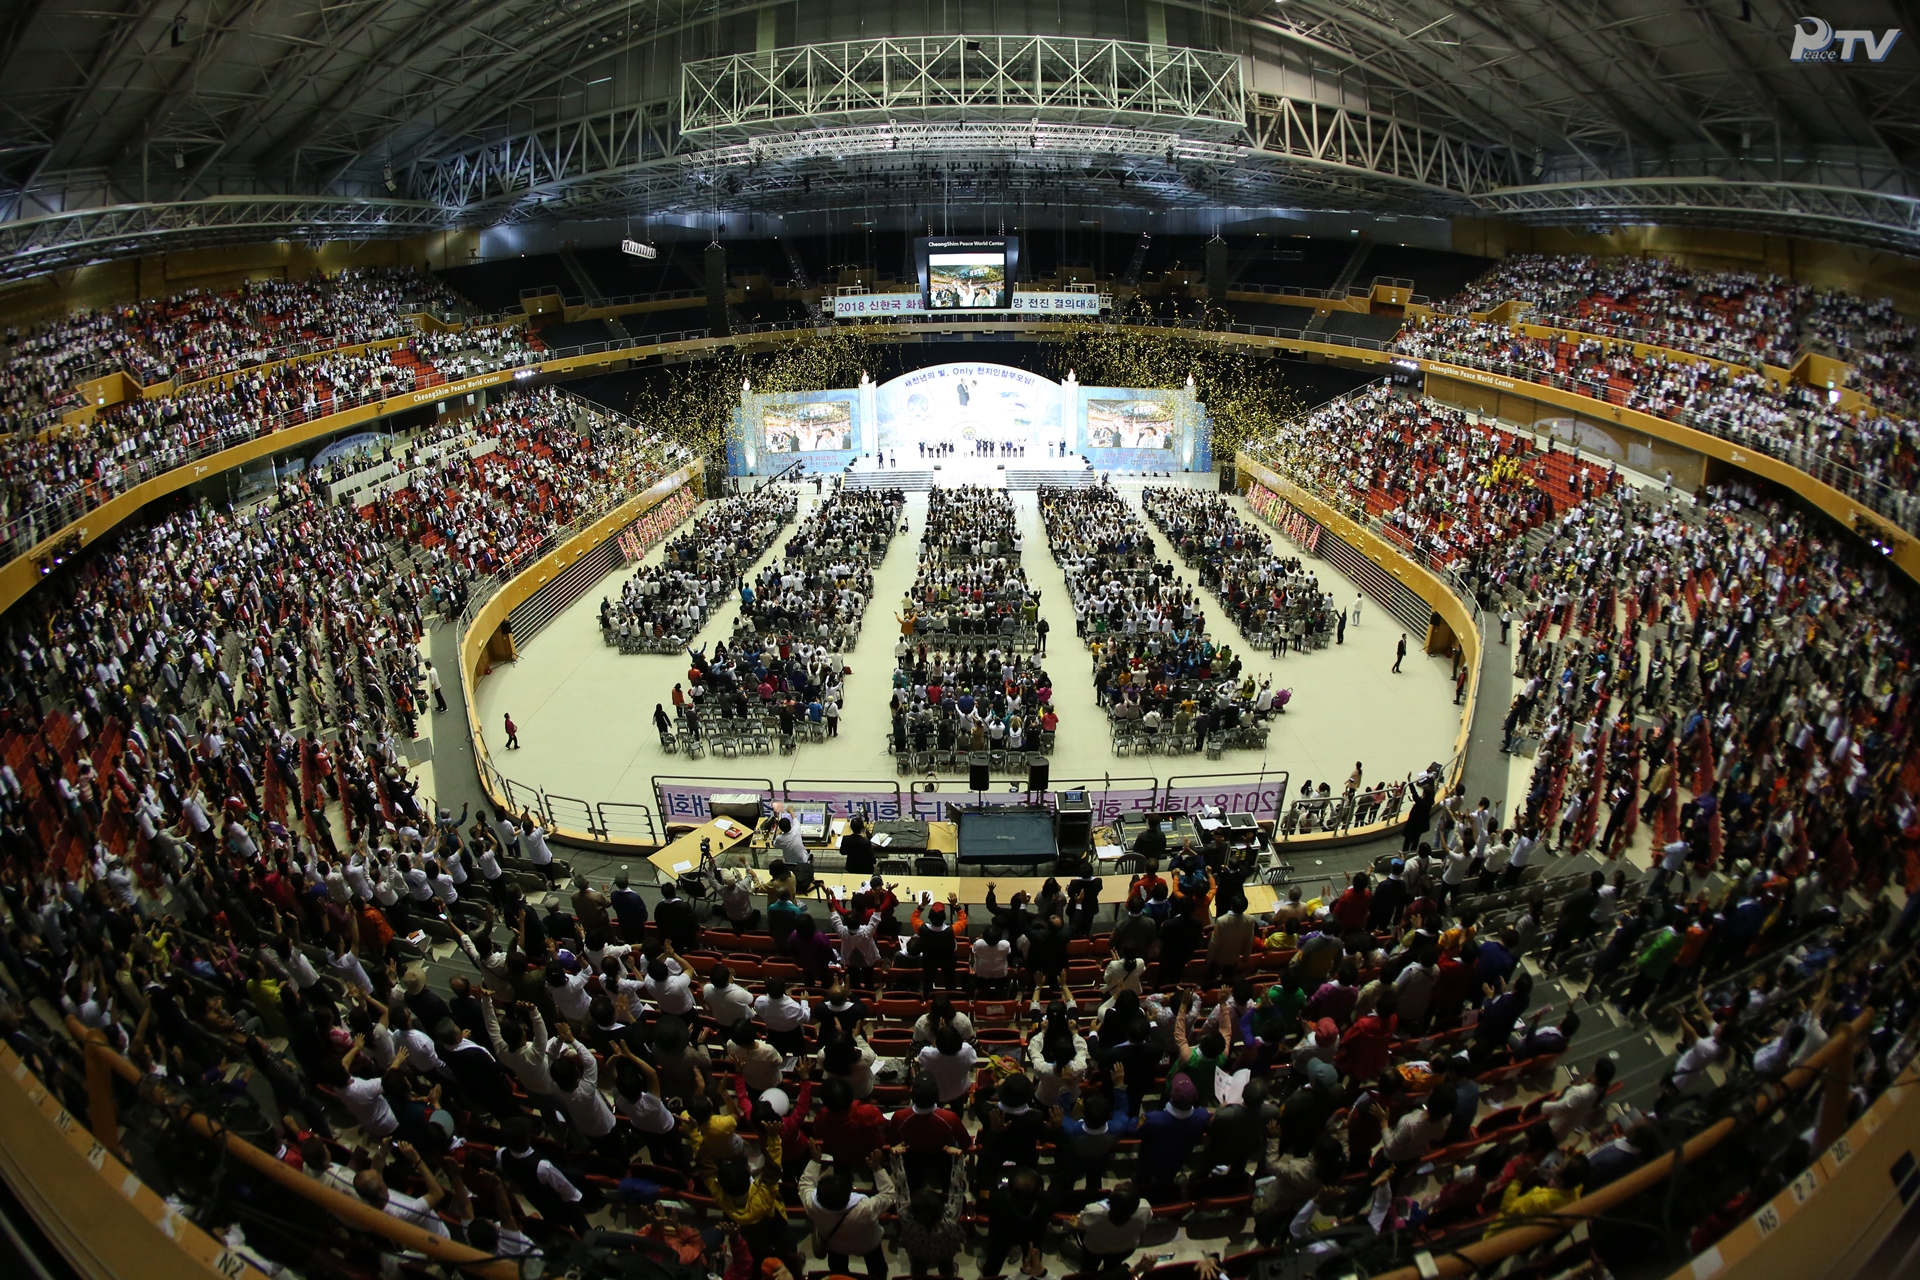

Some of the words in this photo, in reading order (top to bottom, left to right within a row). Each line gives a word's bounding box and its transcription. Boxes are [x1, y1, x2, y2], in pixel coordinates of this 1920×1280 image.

[838, 302, 865, 312] 2018
[869, 300, 901, 311] 신한국
[1028, 298, 1049, 309] 전진
[905, 371, 935, 388] 새천년의
[952, 367, 974, 376] Only
[1429, 363, 1460, 375] CheongShim
[1460, 370, 1476, 379] Peace
[1477, 374, 1493, 384] World
[1494, 378, 1515, 389] Center
[413, 387, 450, 402] CheongShim
[450, 384, 466, 393] Peace
[467, 379, 483, 389] World
[483, 375, 500, 384] Center
